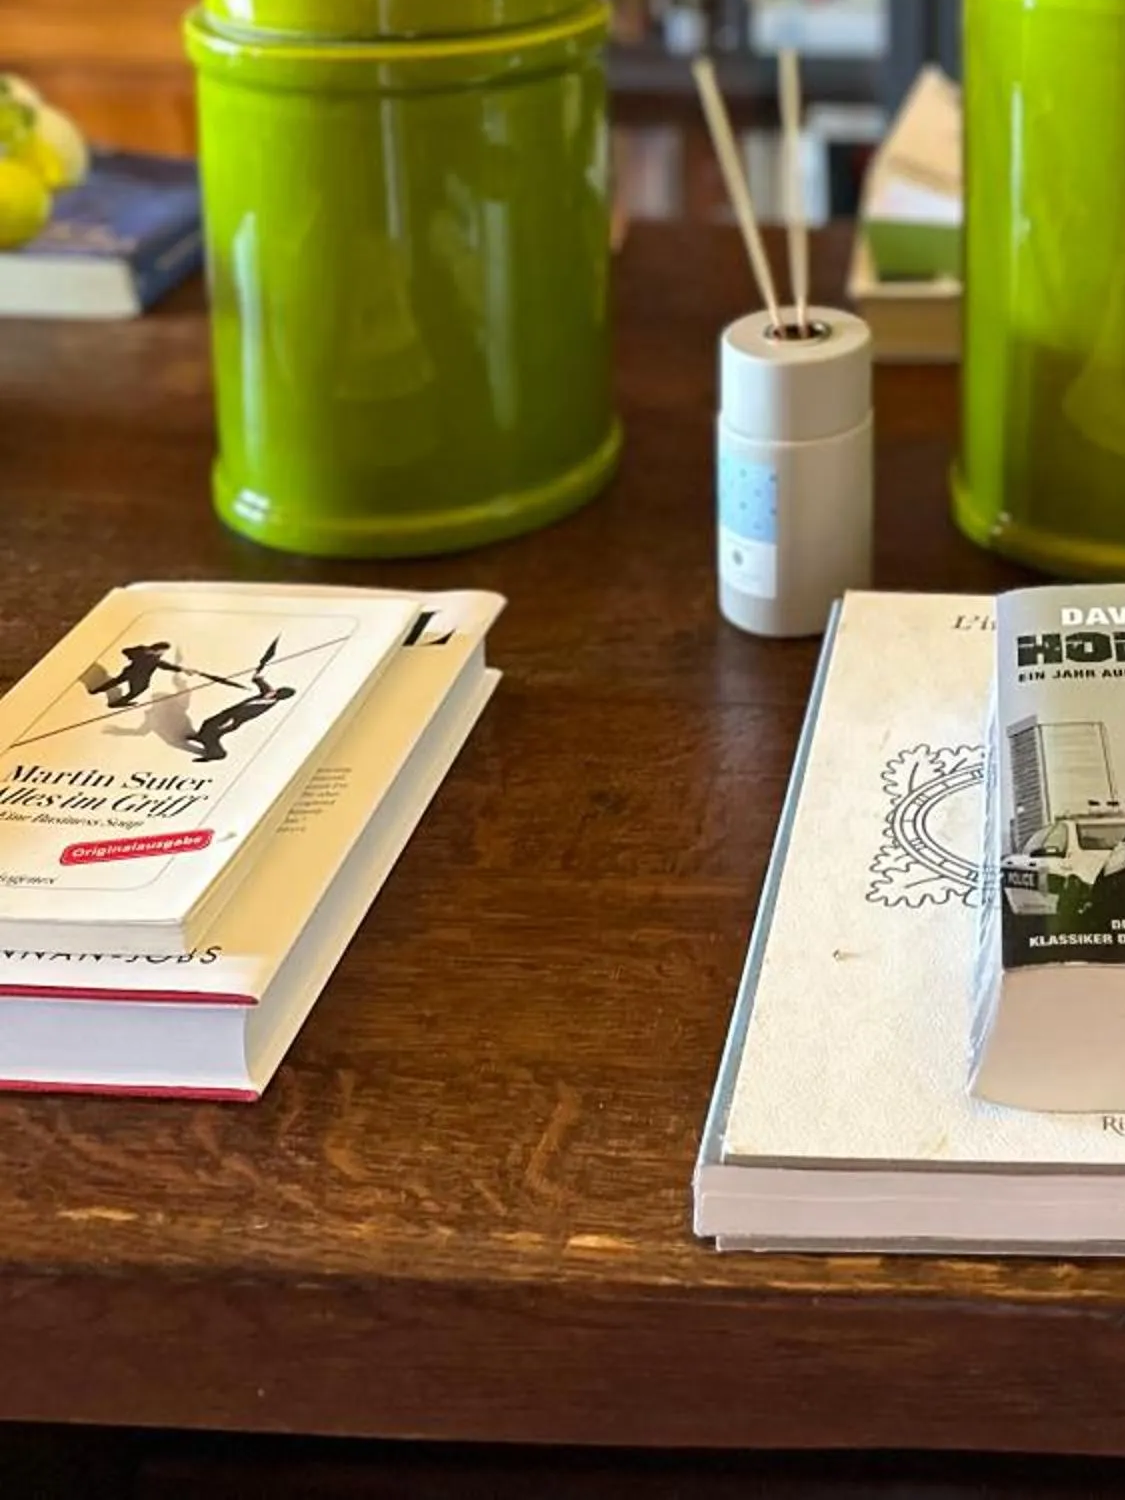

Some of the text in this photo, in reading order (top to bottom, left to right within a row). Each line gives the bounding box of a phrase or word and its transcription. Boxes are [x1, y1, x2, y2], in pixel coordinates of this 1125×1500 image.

[1018, 671, 1046, 683] EIN
[1052, 669, 1096, 680] JAHR
[5, 764, 214, 791] Martin Suter
[59, 791, 107, 811] im
[112, 793, 209, 818] Griff
[71, 835, 203, 858] Originalausgabe
[1029, 932, 1113, 947] KLASSIKER
